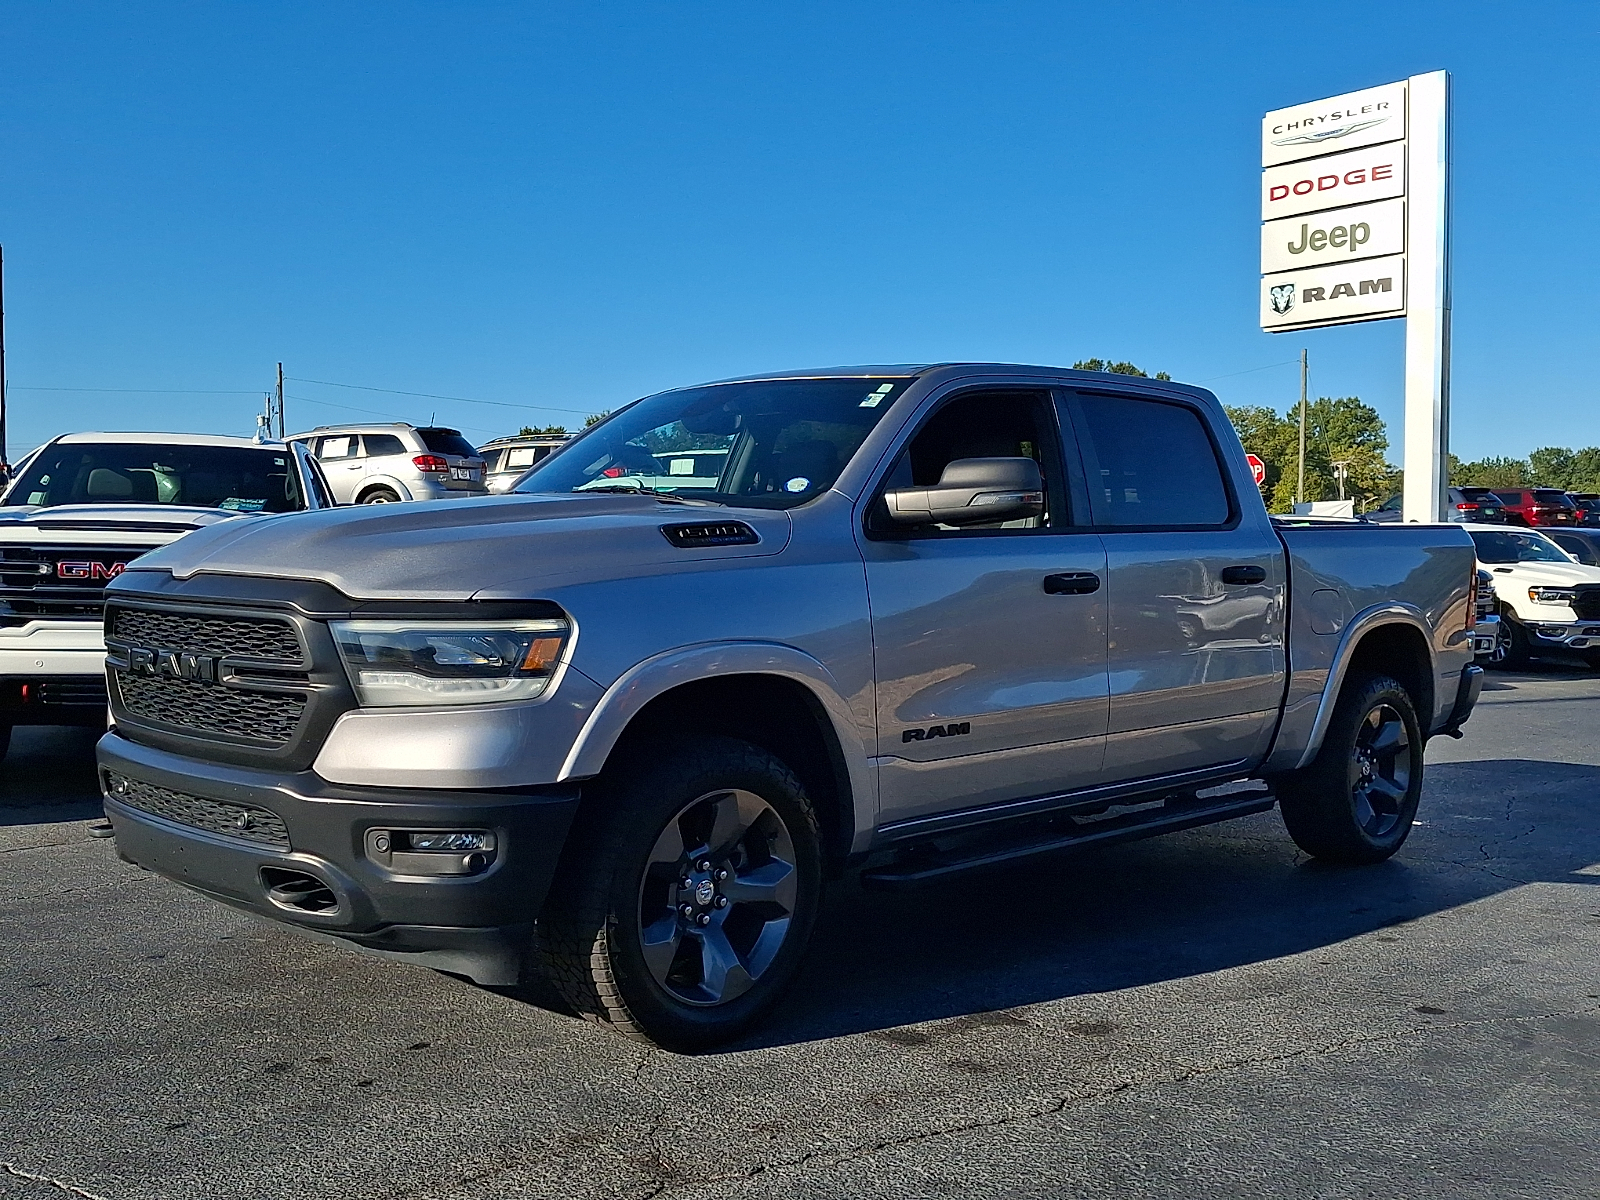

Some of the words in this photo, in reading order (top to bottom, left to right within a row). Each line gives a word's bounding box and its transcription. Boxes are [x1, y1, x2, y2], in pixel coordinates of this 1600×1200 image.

[1273, 102, 1390, 135] CHRYSLER
[1269, 164, 1393, 202] DODGE
[1288, 222, 1371, 255] Jeep
[1302, 277, 1392, 303] RAM
[131, 647, 214, 681] RAM
[902, 722, 971, 743] RAM
